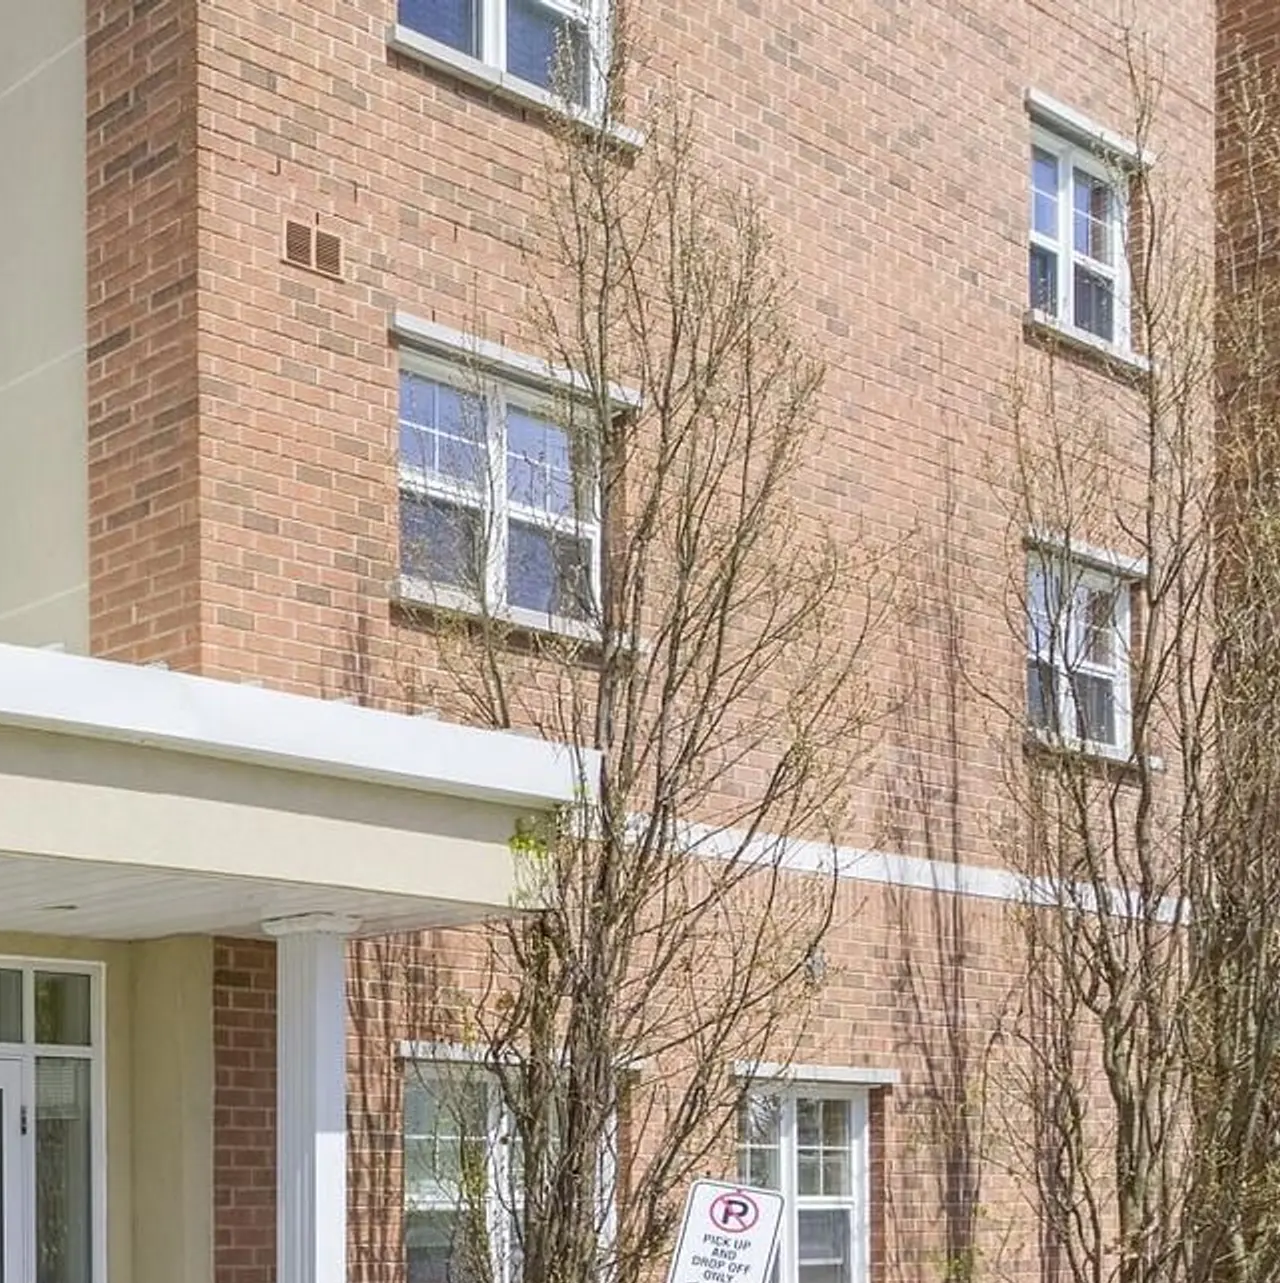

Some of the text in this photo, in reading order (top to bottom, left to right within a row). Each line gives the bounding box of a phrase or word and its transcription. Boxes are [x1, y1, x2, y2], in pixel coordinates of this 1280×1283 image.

[702, 1233, 752, 1251] PICK UP
[711, 1248, 737, 1260] AND
[691, 1255, 752, 1275] DROP OFF
[702, 1270, 734, 1283] ONLY
